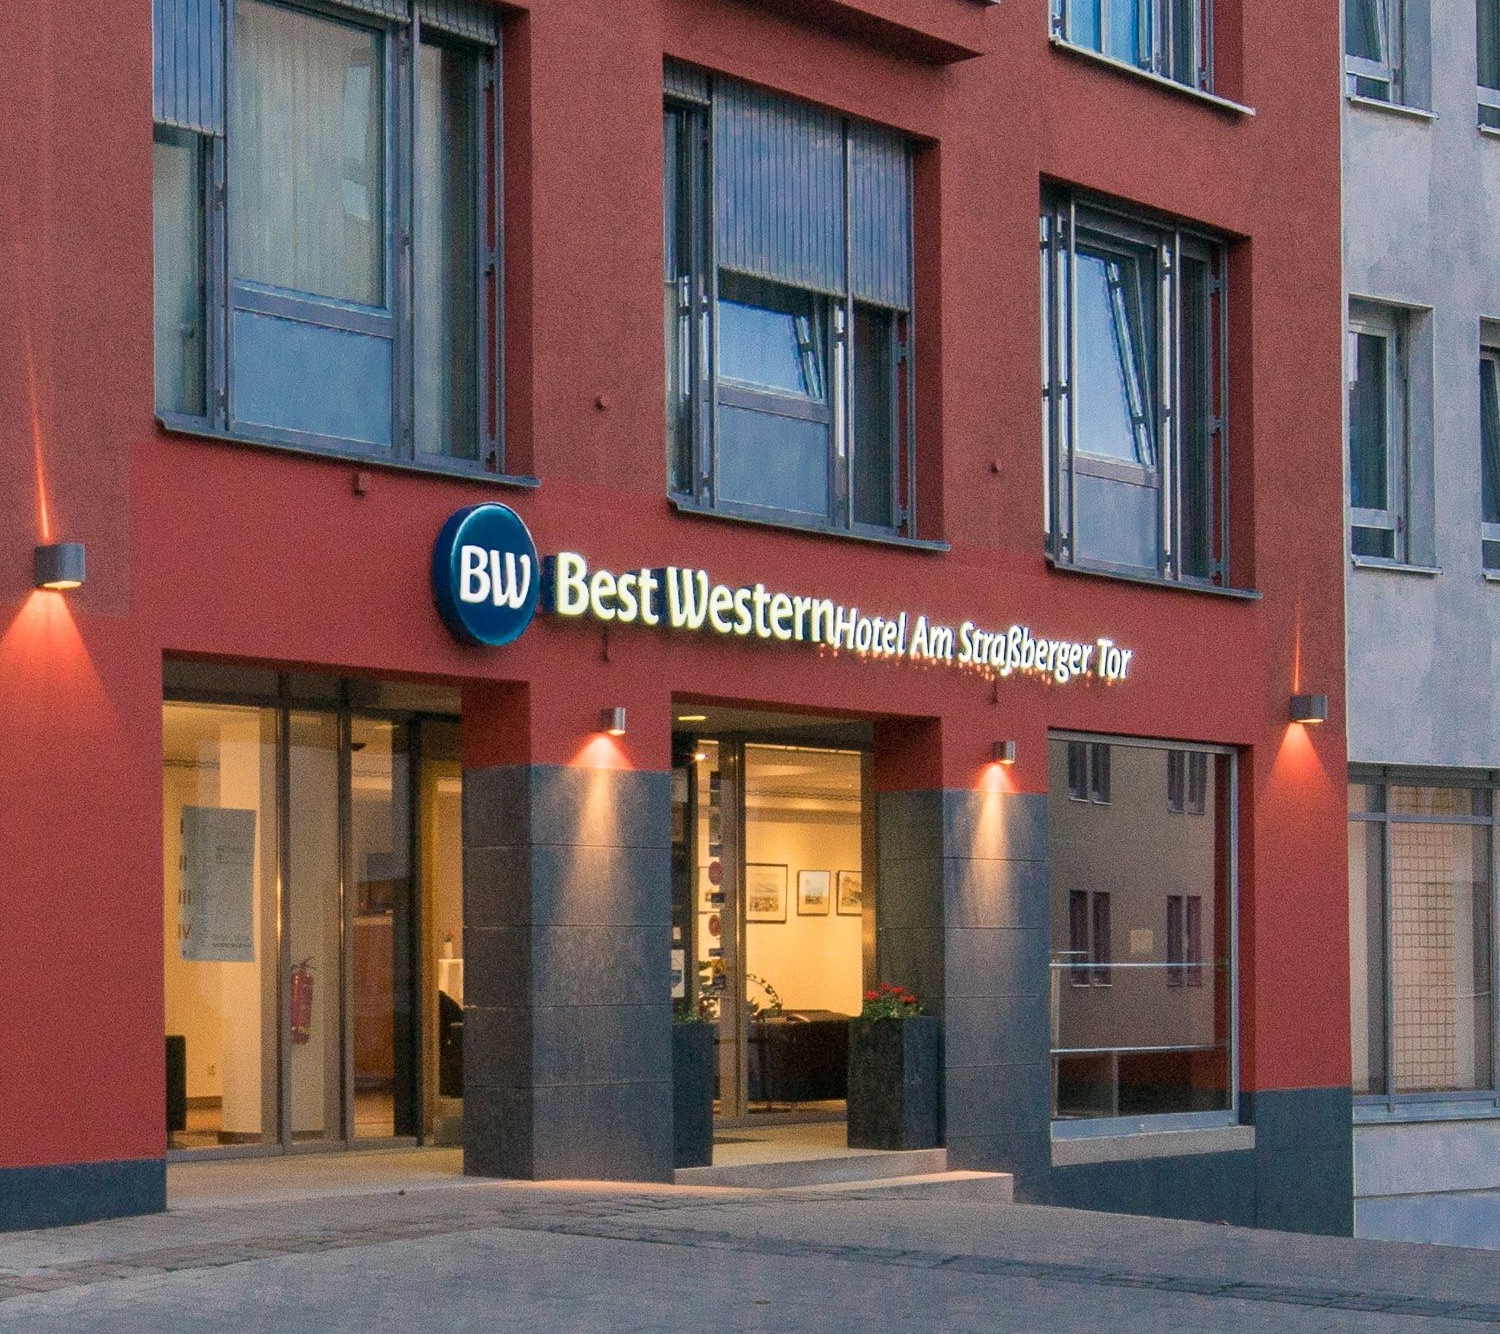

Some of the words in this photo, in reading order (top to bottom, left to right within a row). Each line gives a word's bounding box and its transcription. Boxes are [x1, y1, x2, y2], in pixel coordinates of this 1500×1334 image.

[460, 545, 531, 610] BW
[557, 551, 660, 626] Best
[666, 566, 835, 645] Western
[833, 605, 907, 657] Hotel
[910, 615, 955, 660] Am
[958, 620, 1094, 683] Straßberger
[1097, 638, 1134, 679] Tor
